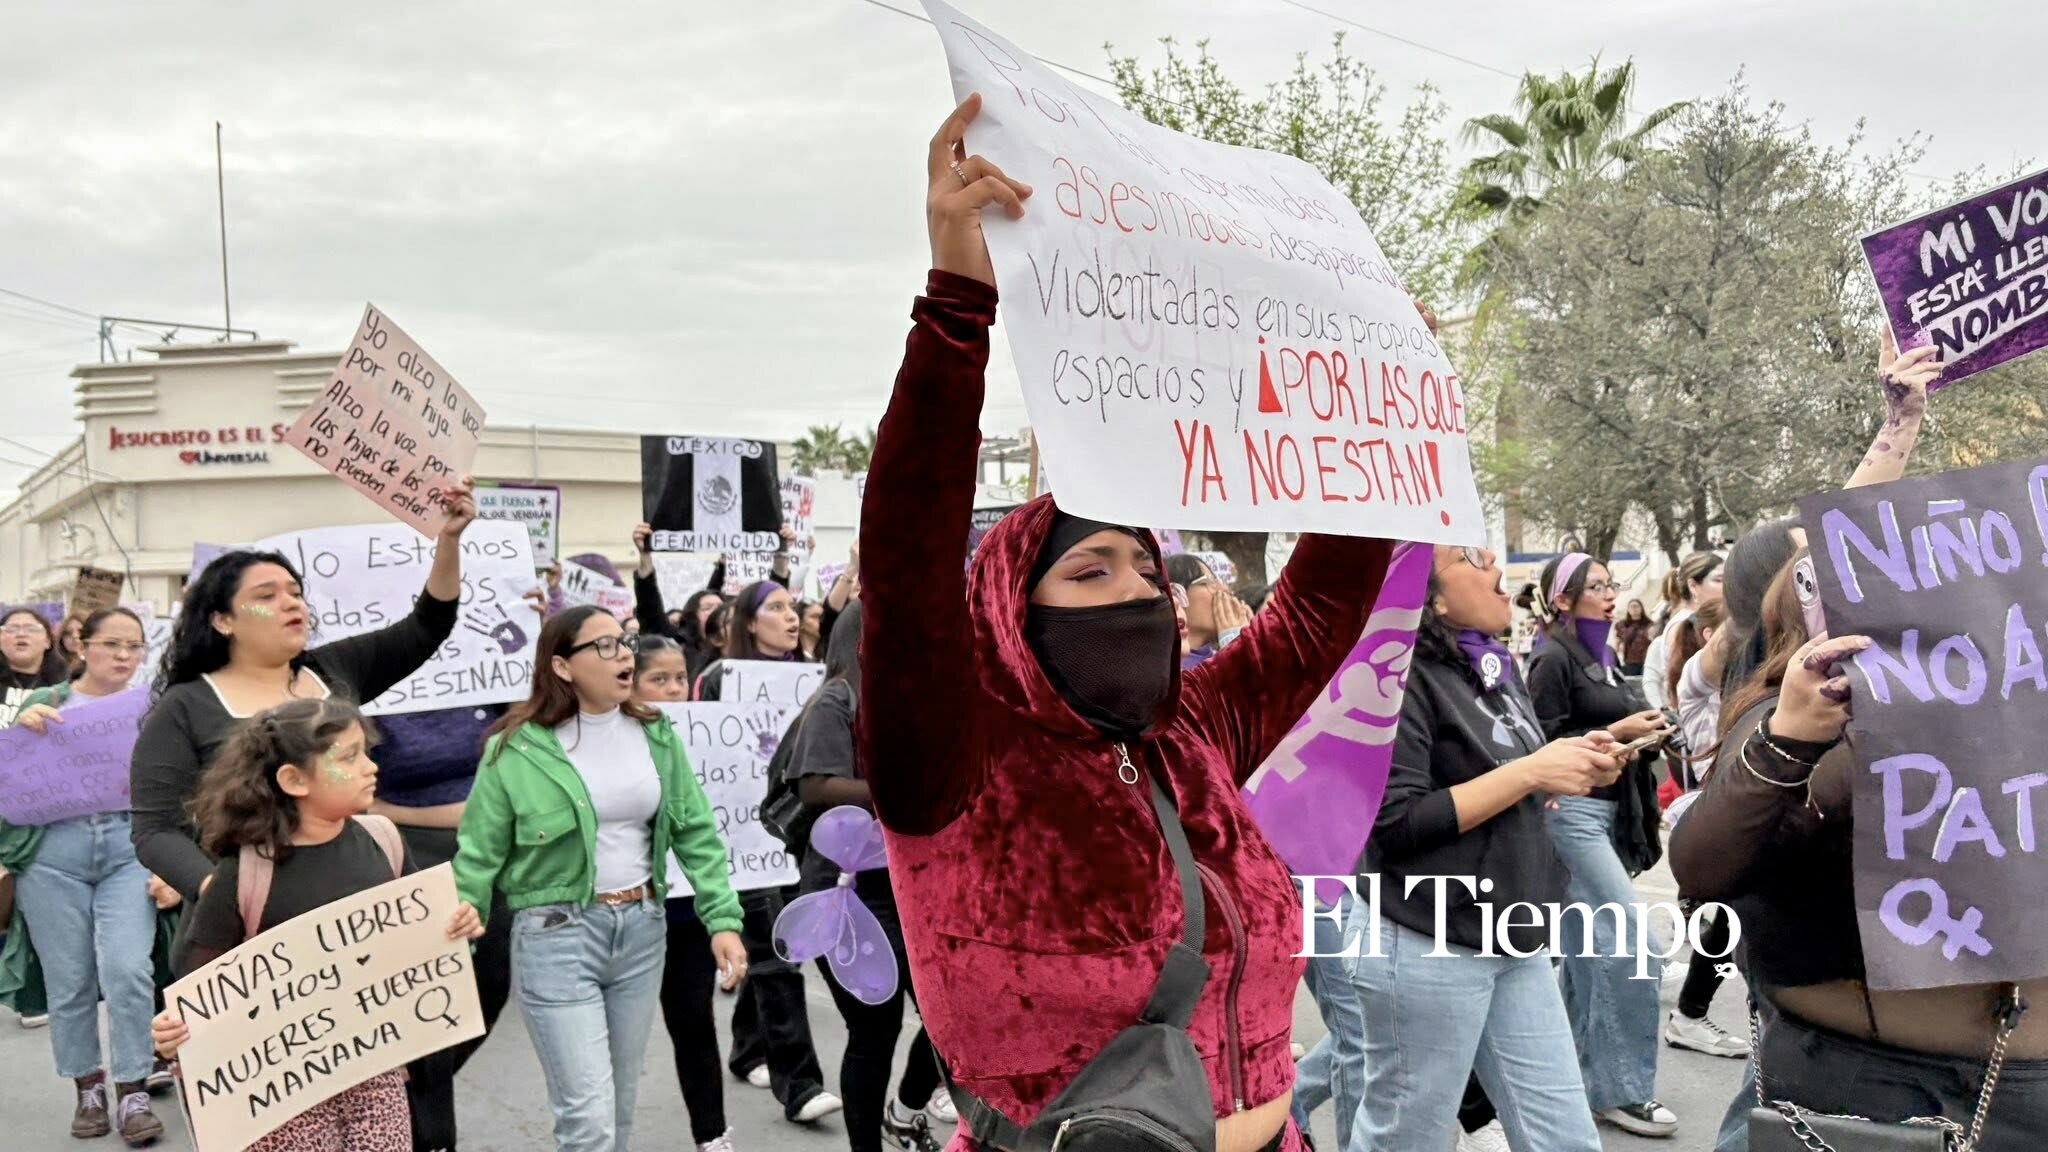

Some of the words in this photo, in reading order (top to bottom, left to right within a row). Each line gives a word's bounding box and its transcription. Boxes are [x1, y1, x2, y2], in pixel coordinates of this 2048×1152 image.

[950, 21, 1080, 128] Por
[1986, 186, 2048, 242] VO
[1027, 246, 1240, 330] Violentadas
[1256, 297, 1288, 337] en
[1296, 303, 1342, 341] sus
[1349, 314, 1438, 360] propios
[1930, 272, 2048, 362] NOMB
[346, 347, 384, 378] por
[392, 380, 414, 402] mi
[363, 309, 388, 349] Yo
[397, 351, 435, 389] alzo
[443, 382, 458, 412] la
[462, 409, 480, 440] voz
[1054, 349, 1205, 422] espacios
[1361, 357, 1418, 430] LAS
[1420, 370, 1465, 434] QUE
[304, 436, 328, 458] no
[336, 457, 386, 494] pueden
[310, 407, 339, 440] las
[344, 428, 380, 464] hijas
[381, 458, 400, 478] de
[326, 380, 364, 420] Alzo
[370, 410, 389, 439] la
[394, 431, 417, 457] voz
[422, 454, 454, 478] por
[1174, 419, 1227, 506] YA
[1244, 429, 1306, 506] NO
[654, 533, 776, 550] FEMINICIDA
[176, 942, 293, 1025] NIÑAS
[316, 888, 430, 953] LIBRES
[272, 963, 342, 1011] HOY
[197, 1007, 336, 1107] MUJERES
[355, 952, 463, 1015] FUERTES
[248, 1022, 401, 1118] MAÑANA
